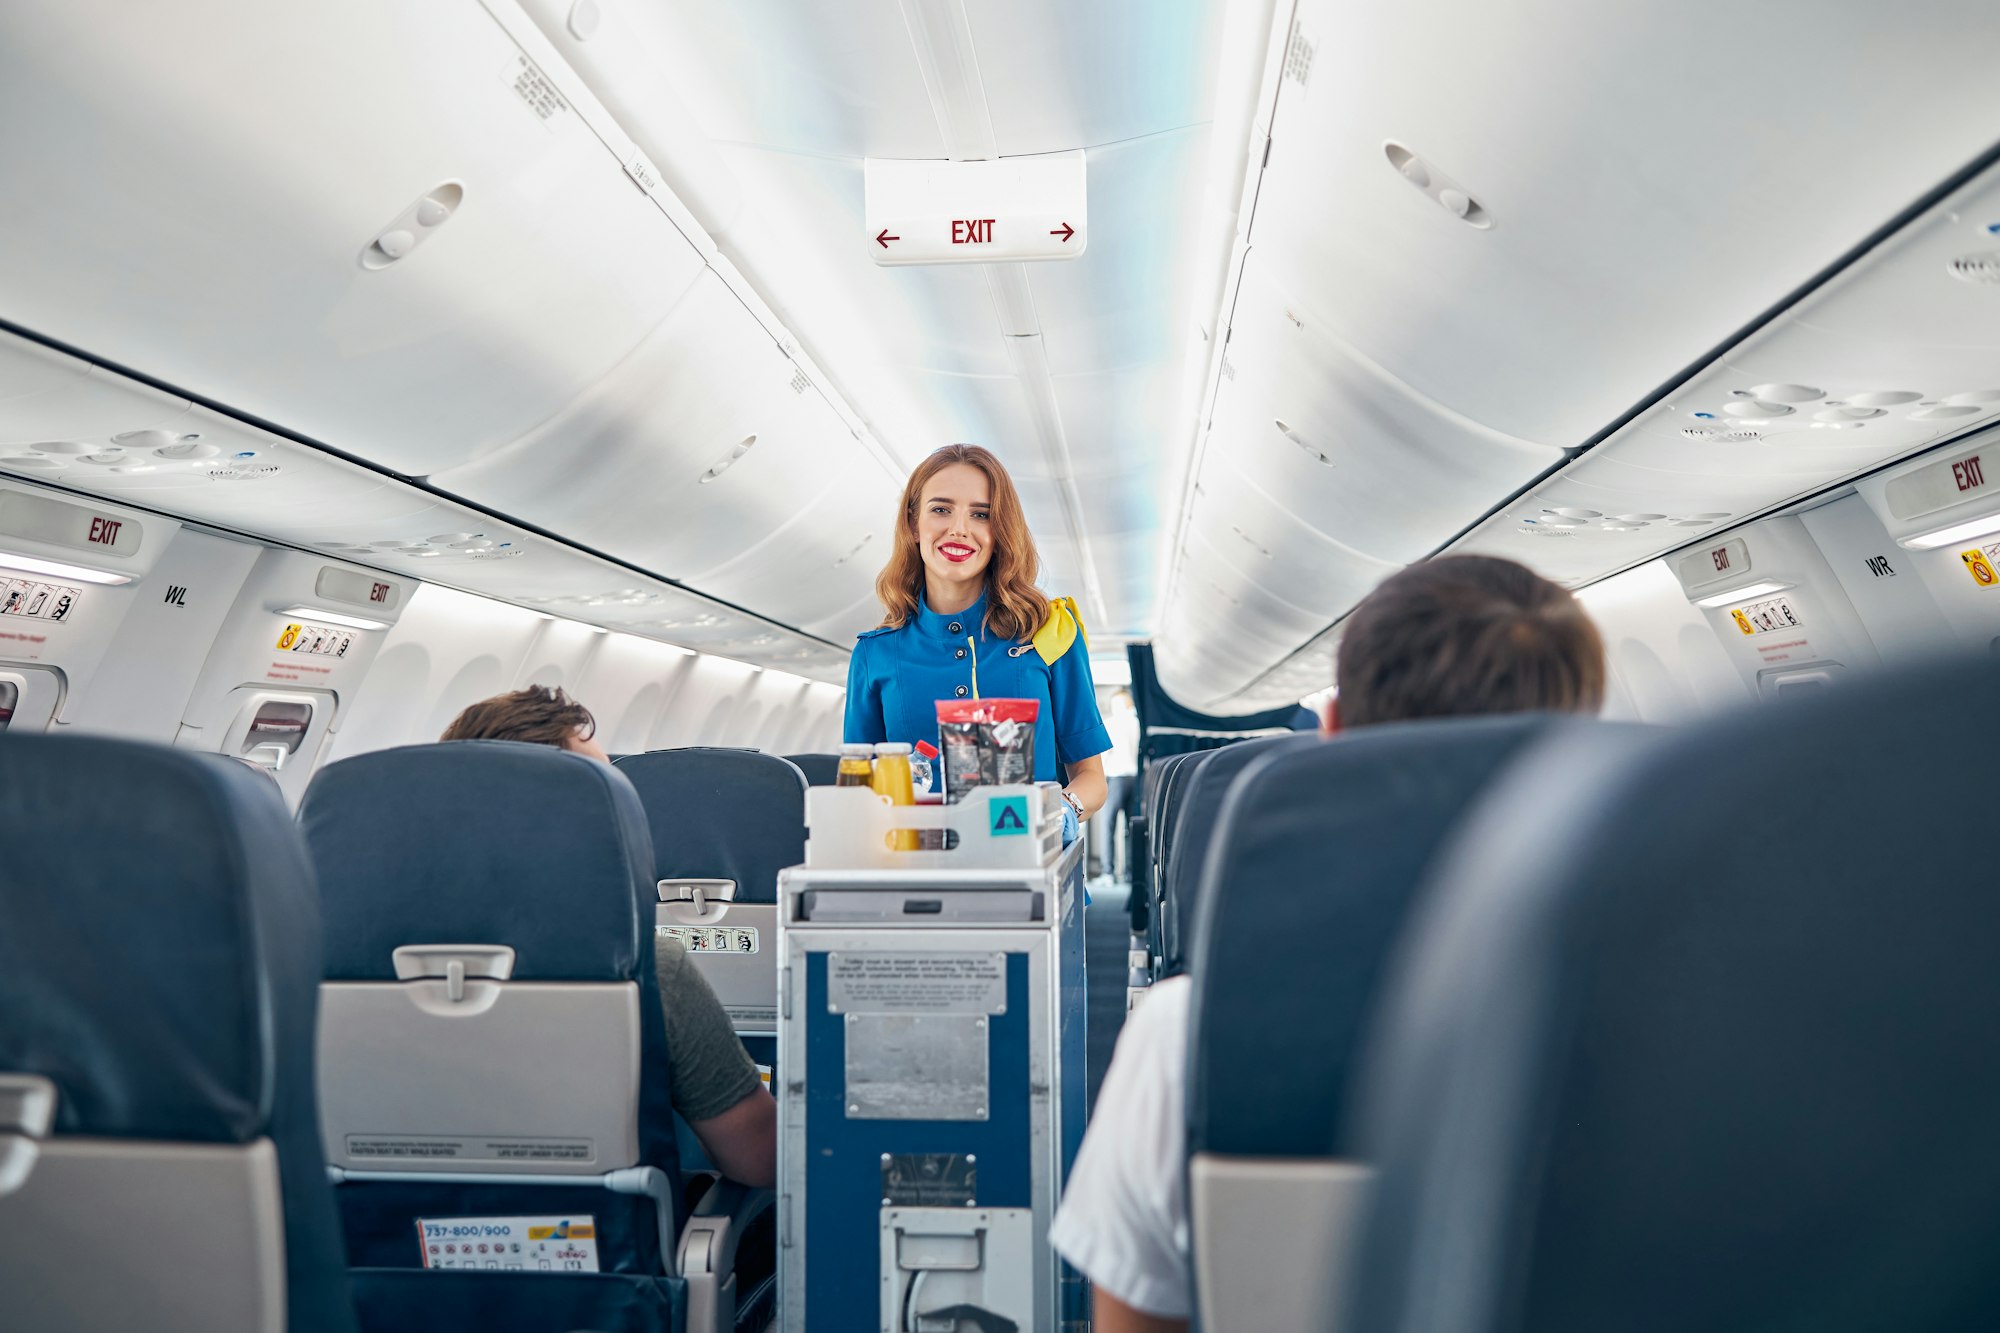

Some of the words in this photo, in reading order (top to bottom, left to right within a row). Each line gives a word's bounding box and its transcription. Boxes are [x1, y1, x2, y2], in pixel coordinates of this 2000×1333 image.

[952, 219, 996, 244] EXIT
[1951, 455, 1985, 492] EXIT
[88, 516, 122, 546] EXIT
[1711, 547, 1730, 572] EXIT
[1865, 554, 1895, 578] WR
[164, 584, 186, 607] WL
[369, 582, 390, 603] EXIT
[425, 1225, 511, 1237] 737-800/900
